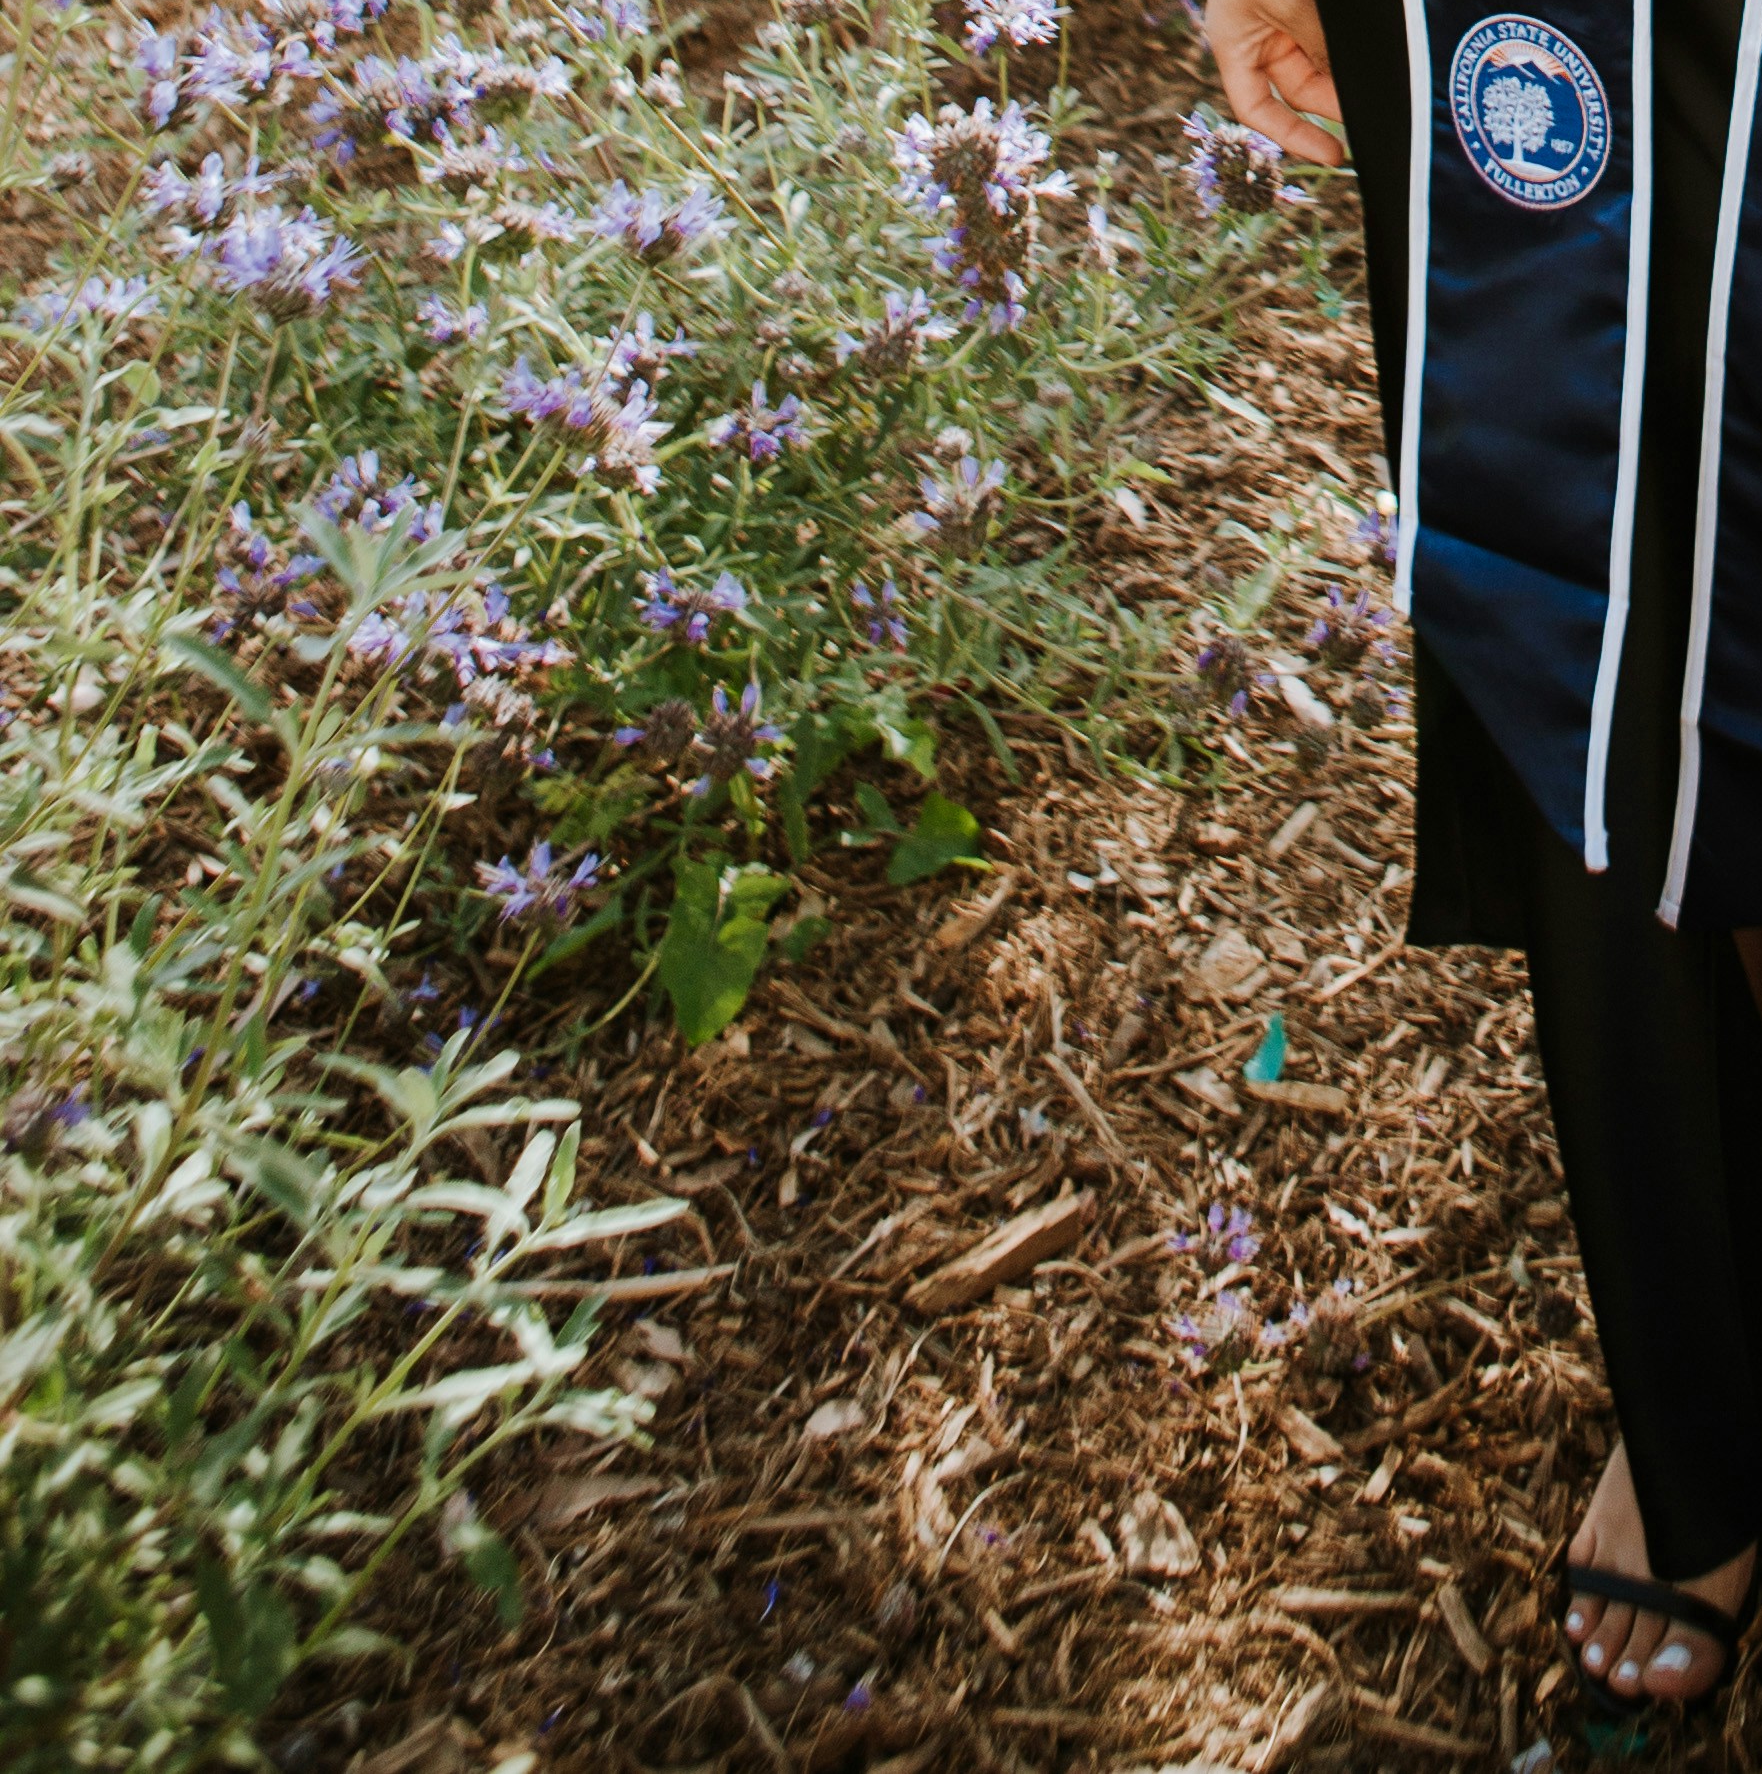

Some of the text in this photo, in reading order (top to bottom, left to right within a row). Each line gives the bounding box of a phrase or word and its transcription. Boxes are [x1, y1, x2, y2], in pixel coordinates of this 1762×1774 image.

[1455, 21, 1606, 162] CALIFORNIA STATE UNIVERSITY
[1483, 157, 1581, 200] FULLERTON
